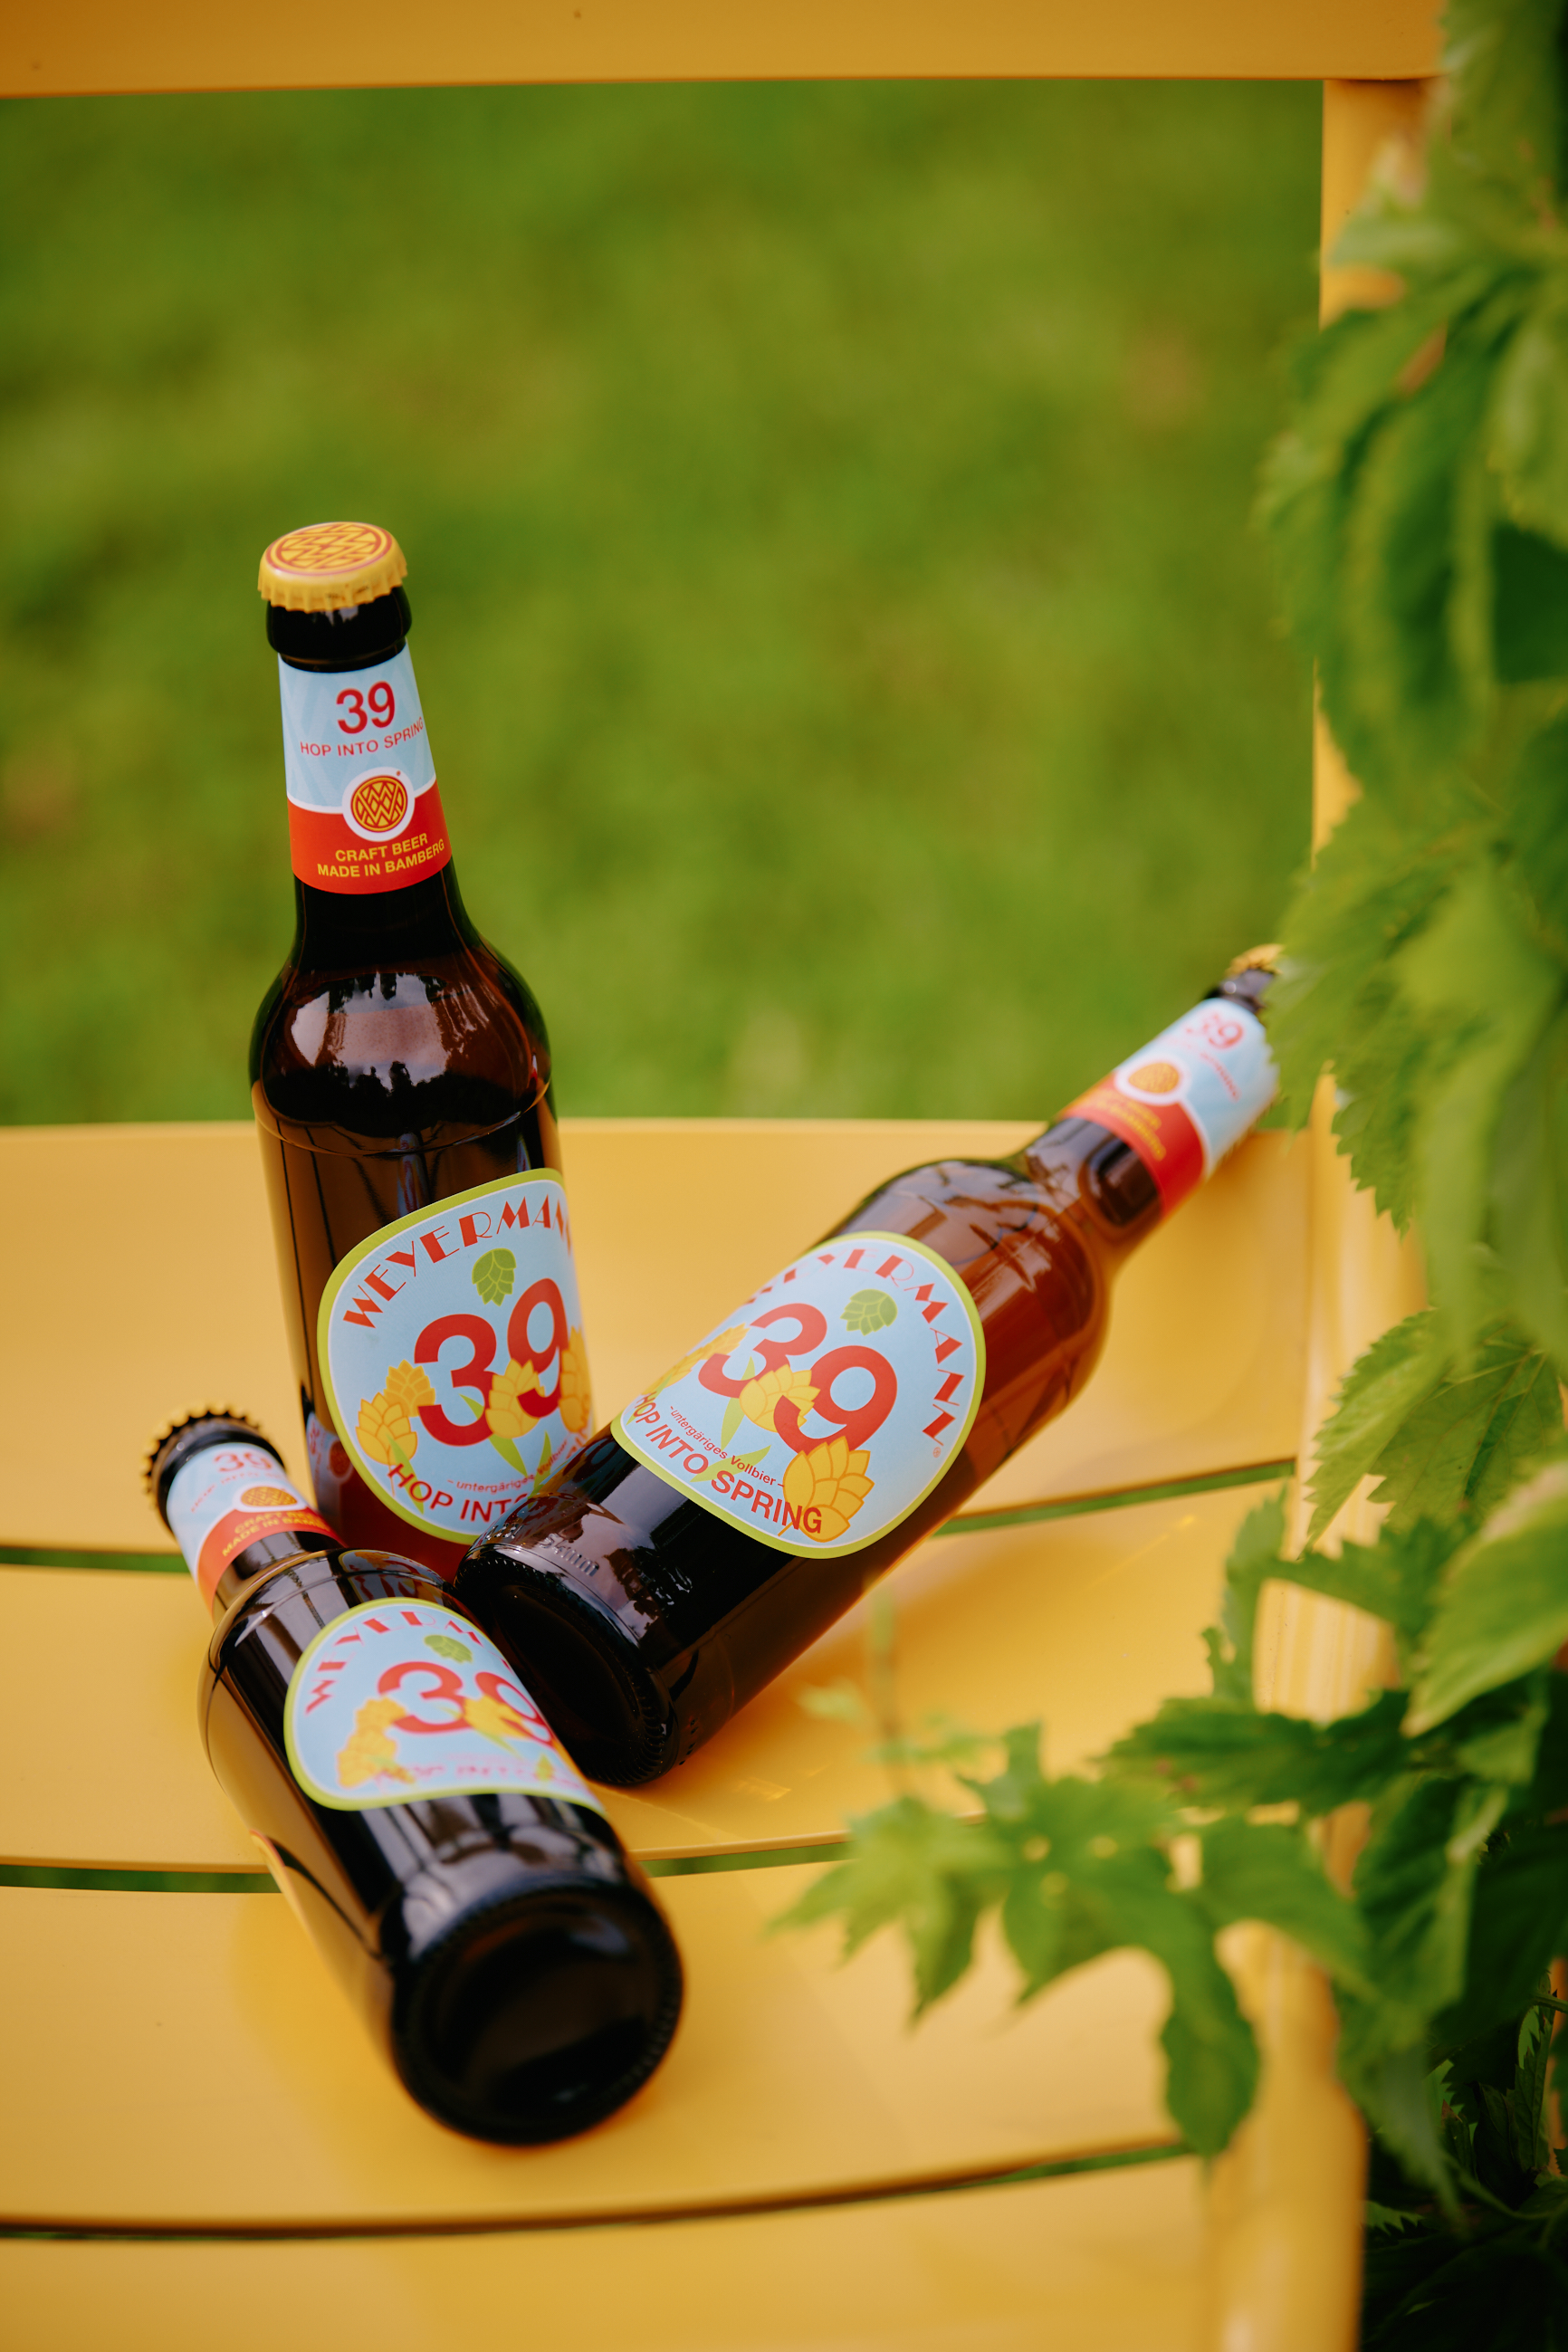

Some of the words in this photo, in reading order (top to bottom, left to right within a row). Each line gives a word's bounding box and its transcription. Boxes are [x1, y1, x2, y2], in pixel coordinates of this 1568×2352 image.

[336, 681, 396, 735] 39
[300, 741, 331, 758] HOP
[338, 739, 379, 757] INTO
[384, 716, 424, 750] SPRING
[317, 863, 361, 877] MADE
[364, 863, 381, 876] IN
[385, 838, 445, 874] BAMBERG
[335, 846, 388, 863] CRAFT
[392, 833, 428, 856] BEER
[414, 1277, 570, 1447] 39
[697, 1303, 898, 1455] 39
[213, 1450, 272, 1472] 39
[671, 1410, 728, 1459] untergäriges
[731, 1455, 777, 1486] Vollbier
[387, 1463, 453, 1510] HOP
[459, 1492, 528, 1523] INT
[645, 1423, 709, 1475] INTO
[711, 1469, 822, 1535] SPRING
[222, 1525, 260, 1557] MADE
[377, 1660, 557, 1749] 39
